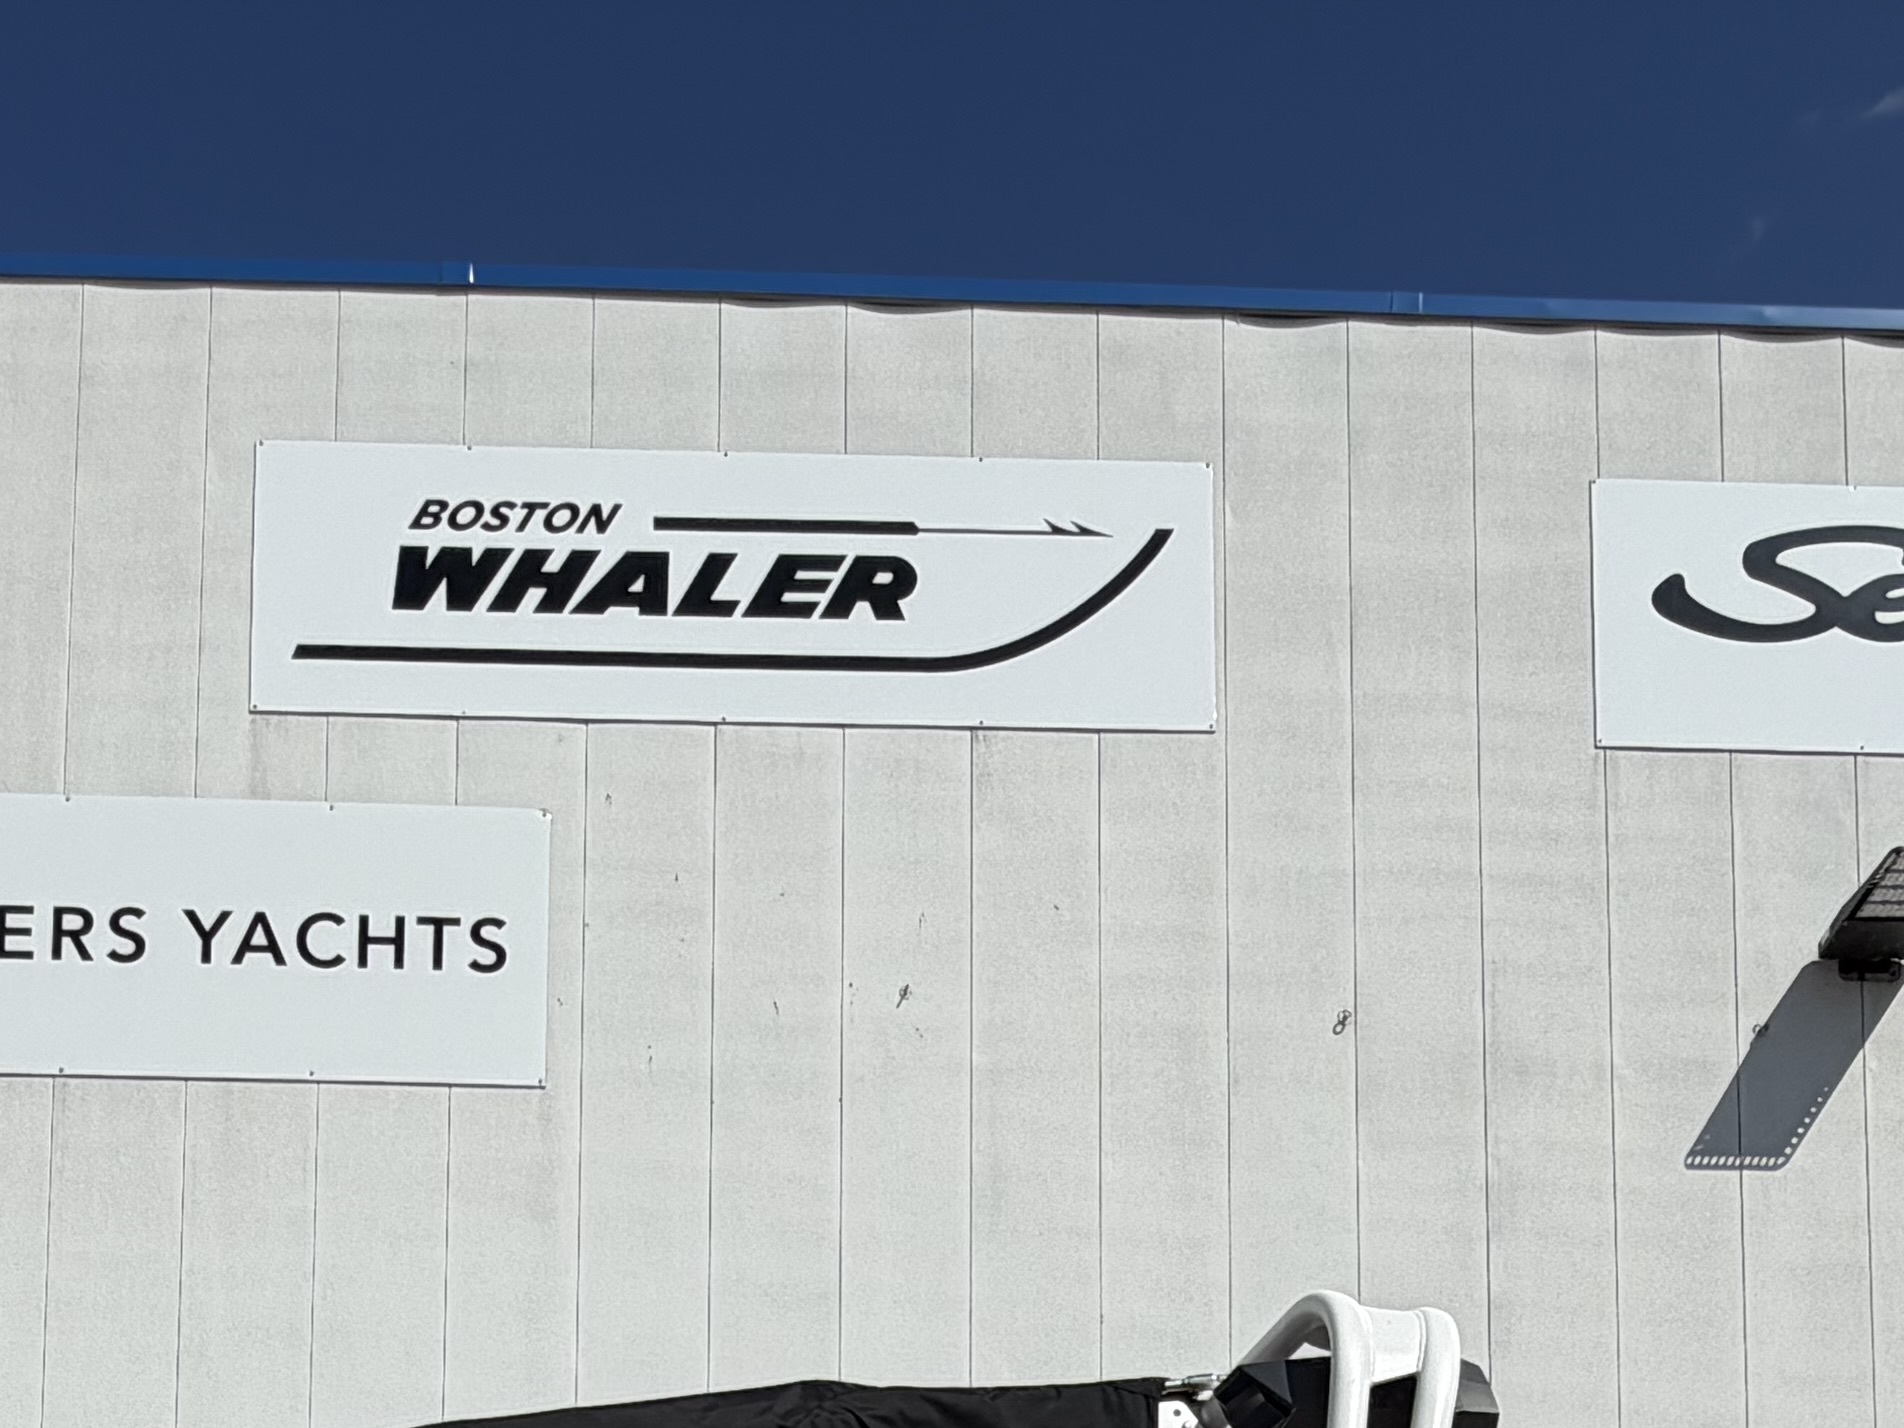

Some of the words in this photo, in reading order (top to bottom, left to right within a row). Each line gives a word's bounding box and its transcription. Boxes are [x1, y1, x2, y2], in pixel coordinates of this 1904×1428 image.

[408, 499, 623, 535] BOSTON
[391, 545, 918, 621] WHALER
[182, 909, 507, 974] YACHTS
